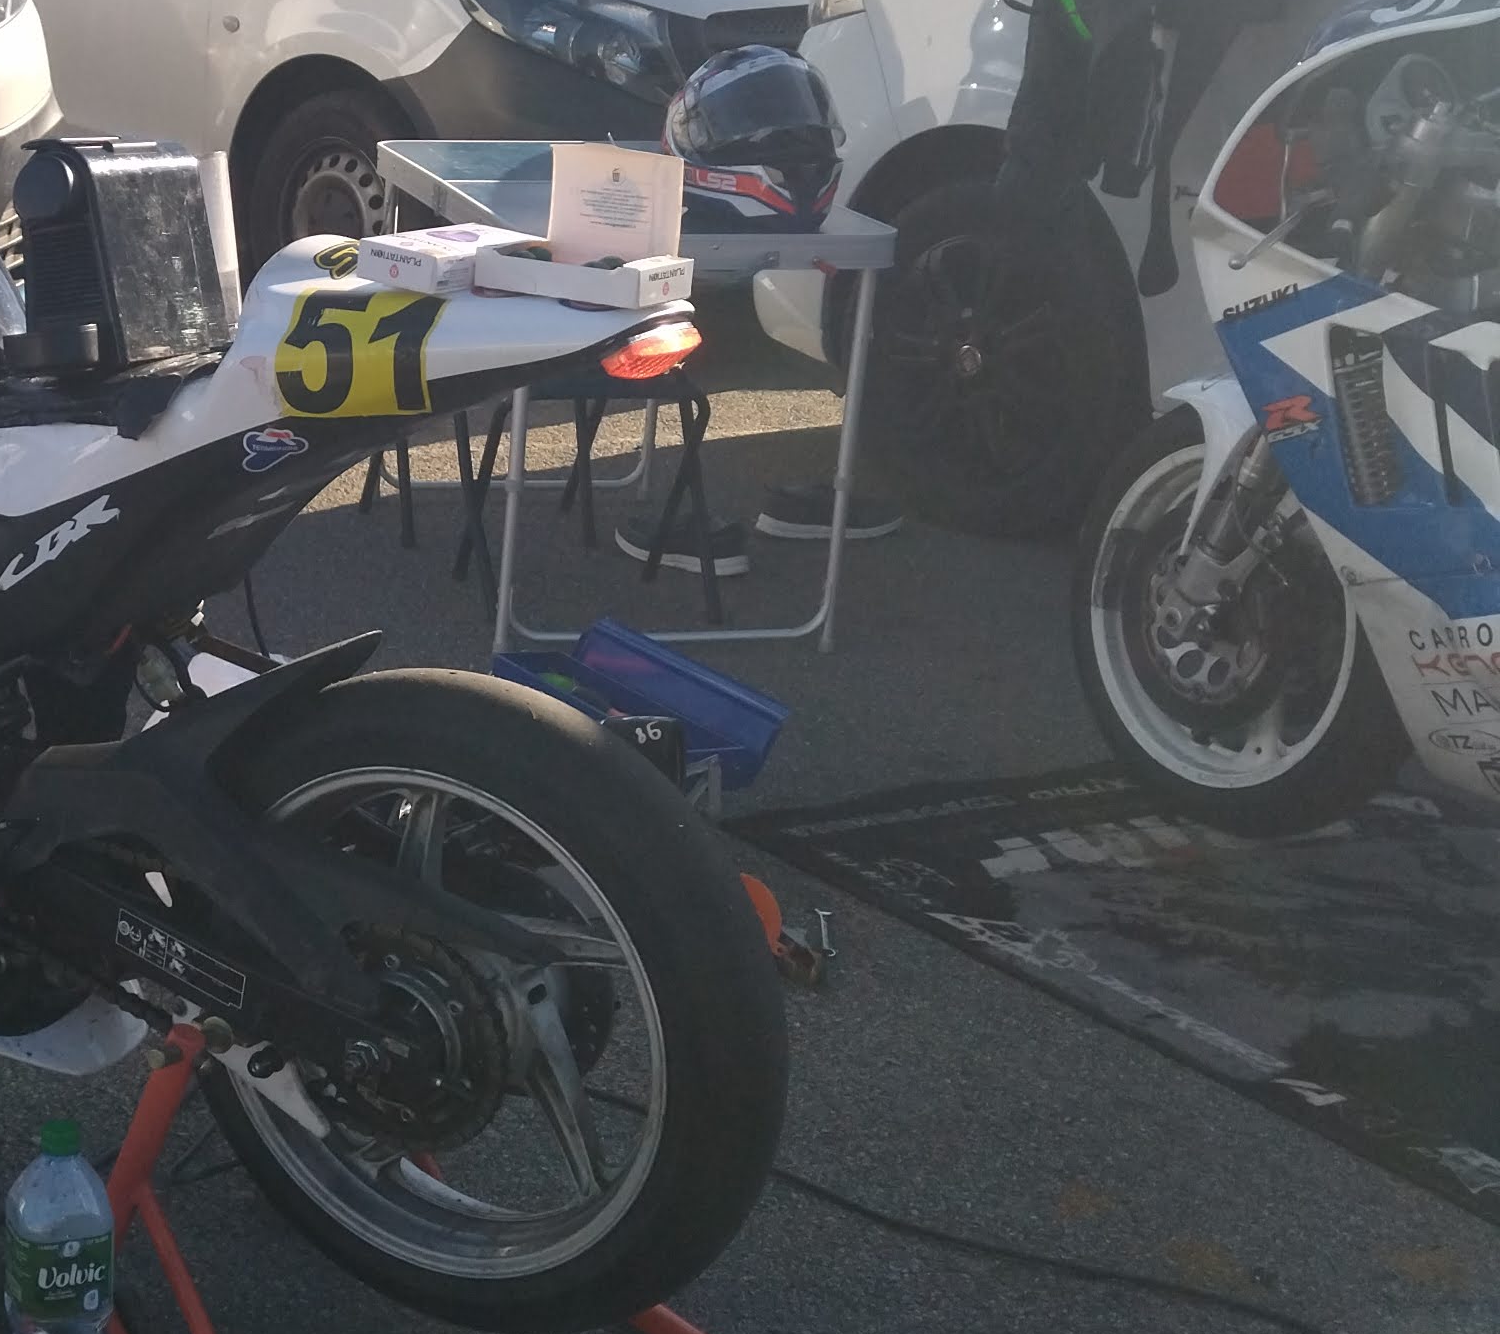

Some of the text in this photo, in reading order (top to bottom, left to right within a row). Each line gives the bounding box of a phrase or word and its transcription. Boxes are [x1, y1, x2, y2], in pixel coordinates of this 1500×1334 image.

[696, 169, 737, 191] LS2
[1222, 282, 1300, 320] SUZUKI
[275, 289, 447, 414] 51
[38, 1262, 106, 1289] Volvic
